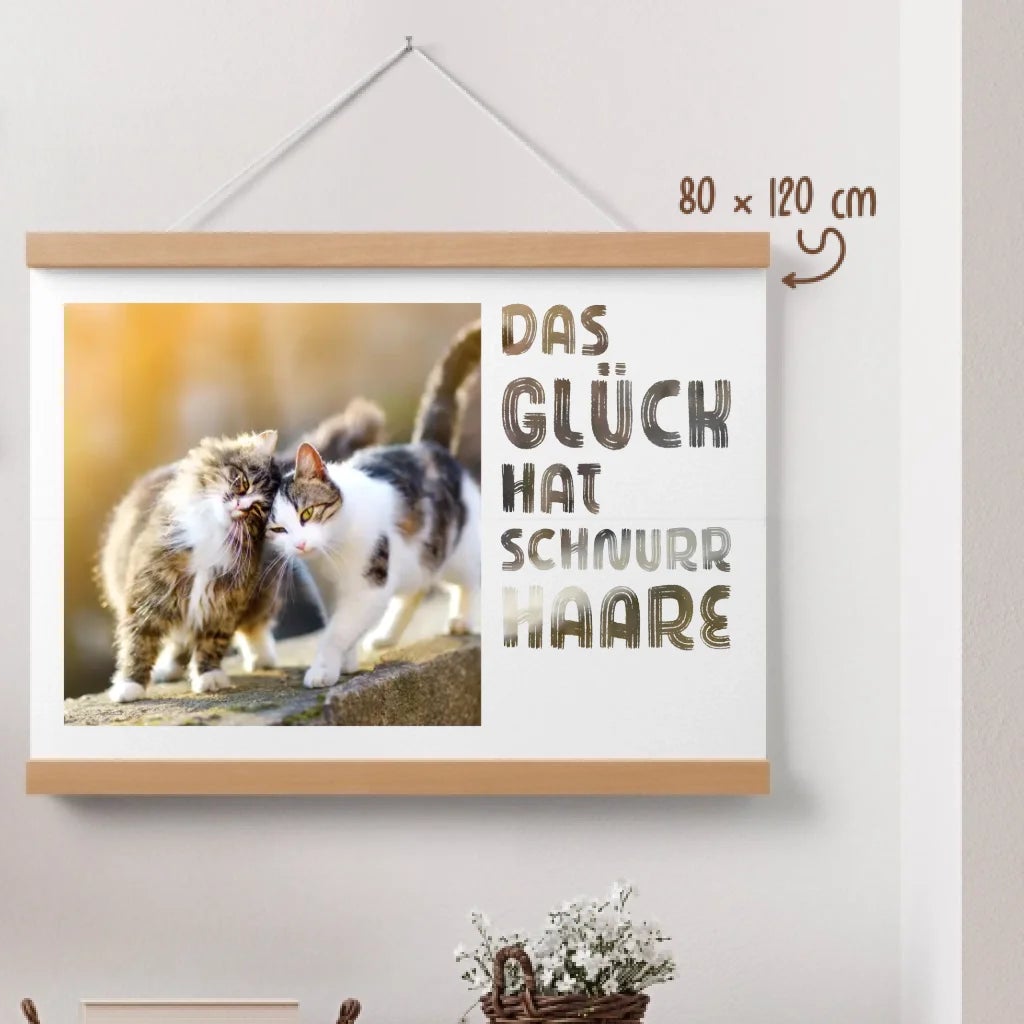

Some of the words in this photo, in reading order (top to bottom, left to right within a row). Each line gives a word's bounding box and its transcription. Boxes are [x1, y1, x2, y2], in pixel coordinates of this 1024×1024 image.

[502, 303, 609, 356] DAS
[502, 362, 731, 451] GLÜCK
[501, 462, 601, 515] HAT
[501, 527, 731, 572] SCHNURR
[503, 584, 731, 651] HAARE
